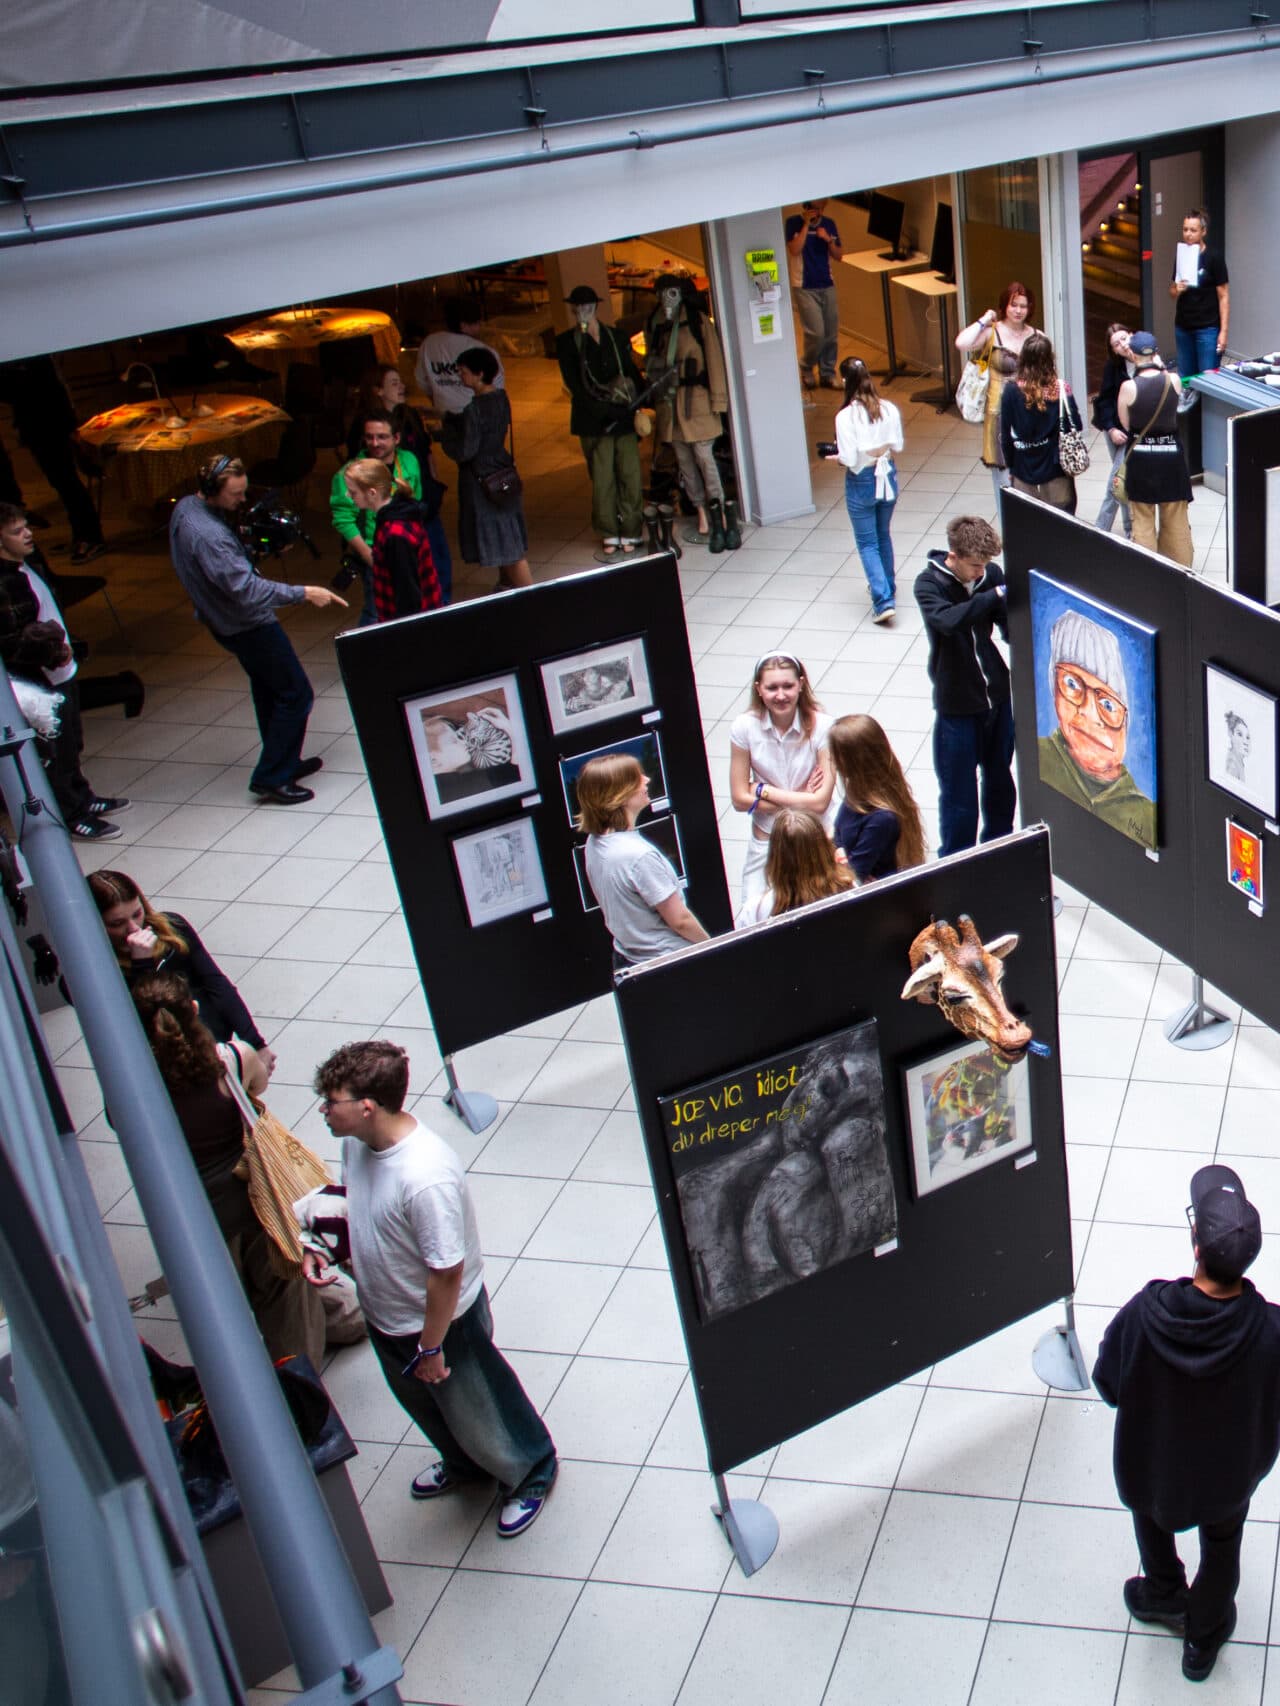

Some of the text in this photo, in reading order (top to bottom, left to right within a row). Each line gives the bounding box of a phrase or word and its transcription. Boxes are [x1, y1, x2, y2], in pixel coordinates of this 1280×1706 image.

[756, 1065, 800, 1097] idiot
[672, 1131, 694, 1153] du
[700, 1121, 760, 1145] dreper
